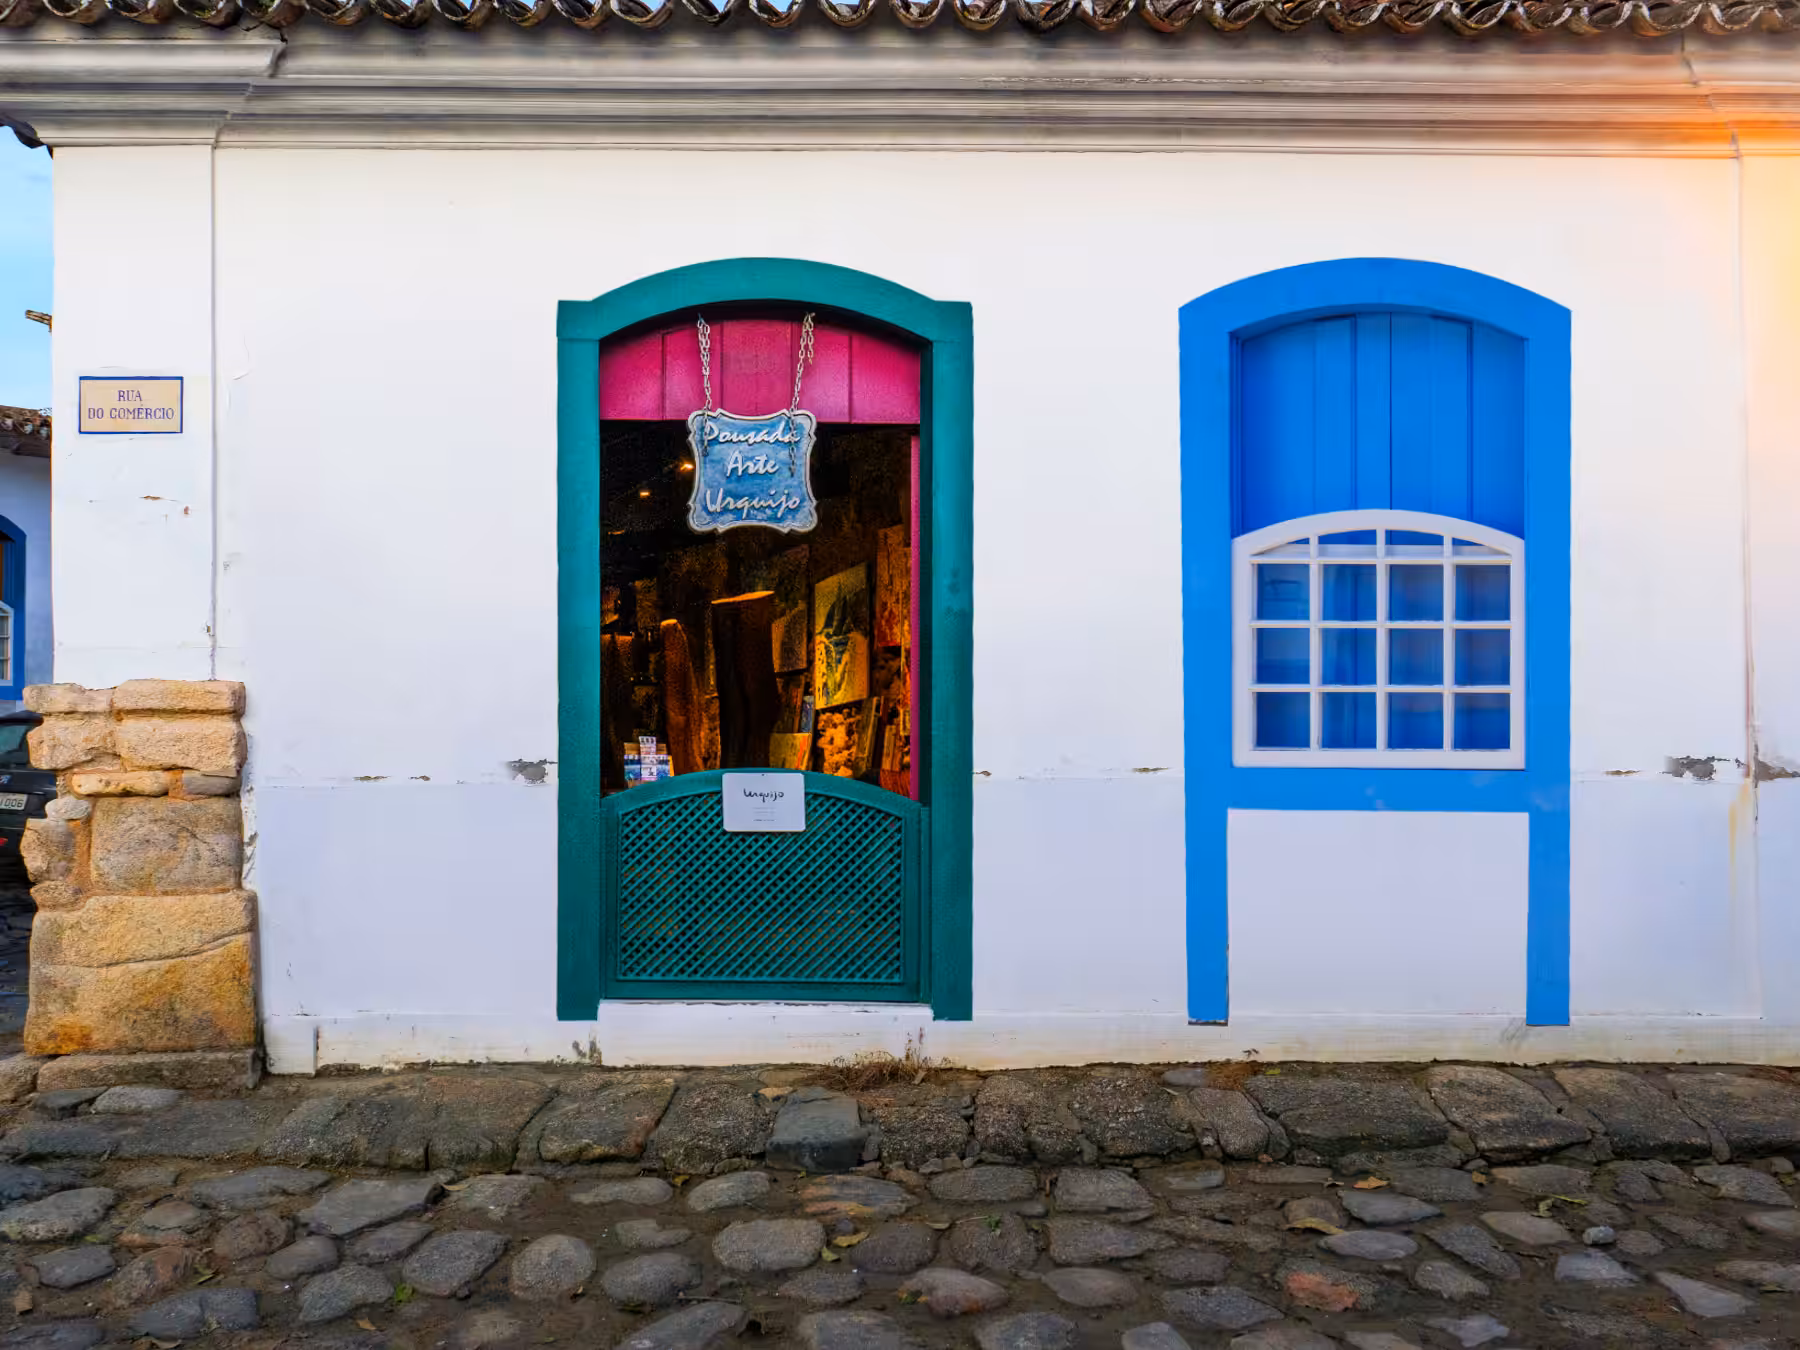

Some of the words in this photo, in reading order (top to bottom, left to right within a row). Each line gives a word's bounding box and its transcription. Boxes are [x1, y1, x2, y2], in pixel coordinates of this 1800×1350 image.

[117, 389, 143, 402] RUA
[87, 407, 104, 420] DO
[109, 403, 175, 420] COMÉRCIO
[705, 421, 801, 446] Pousada
[726, 449, 779, 477] Arte
[706, 487, 801, 519] Urquijo
